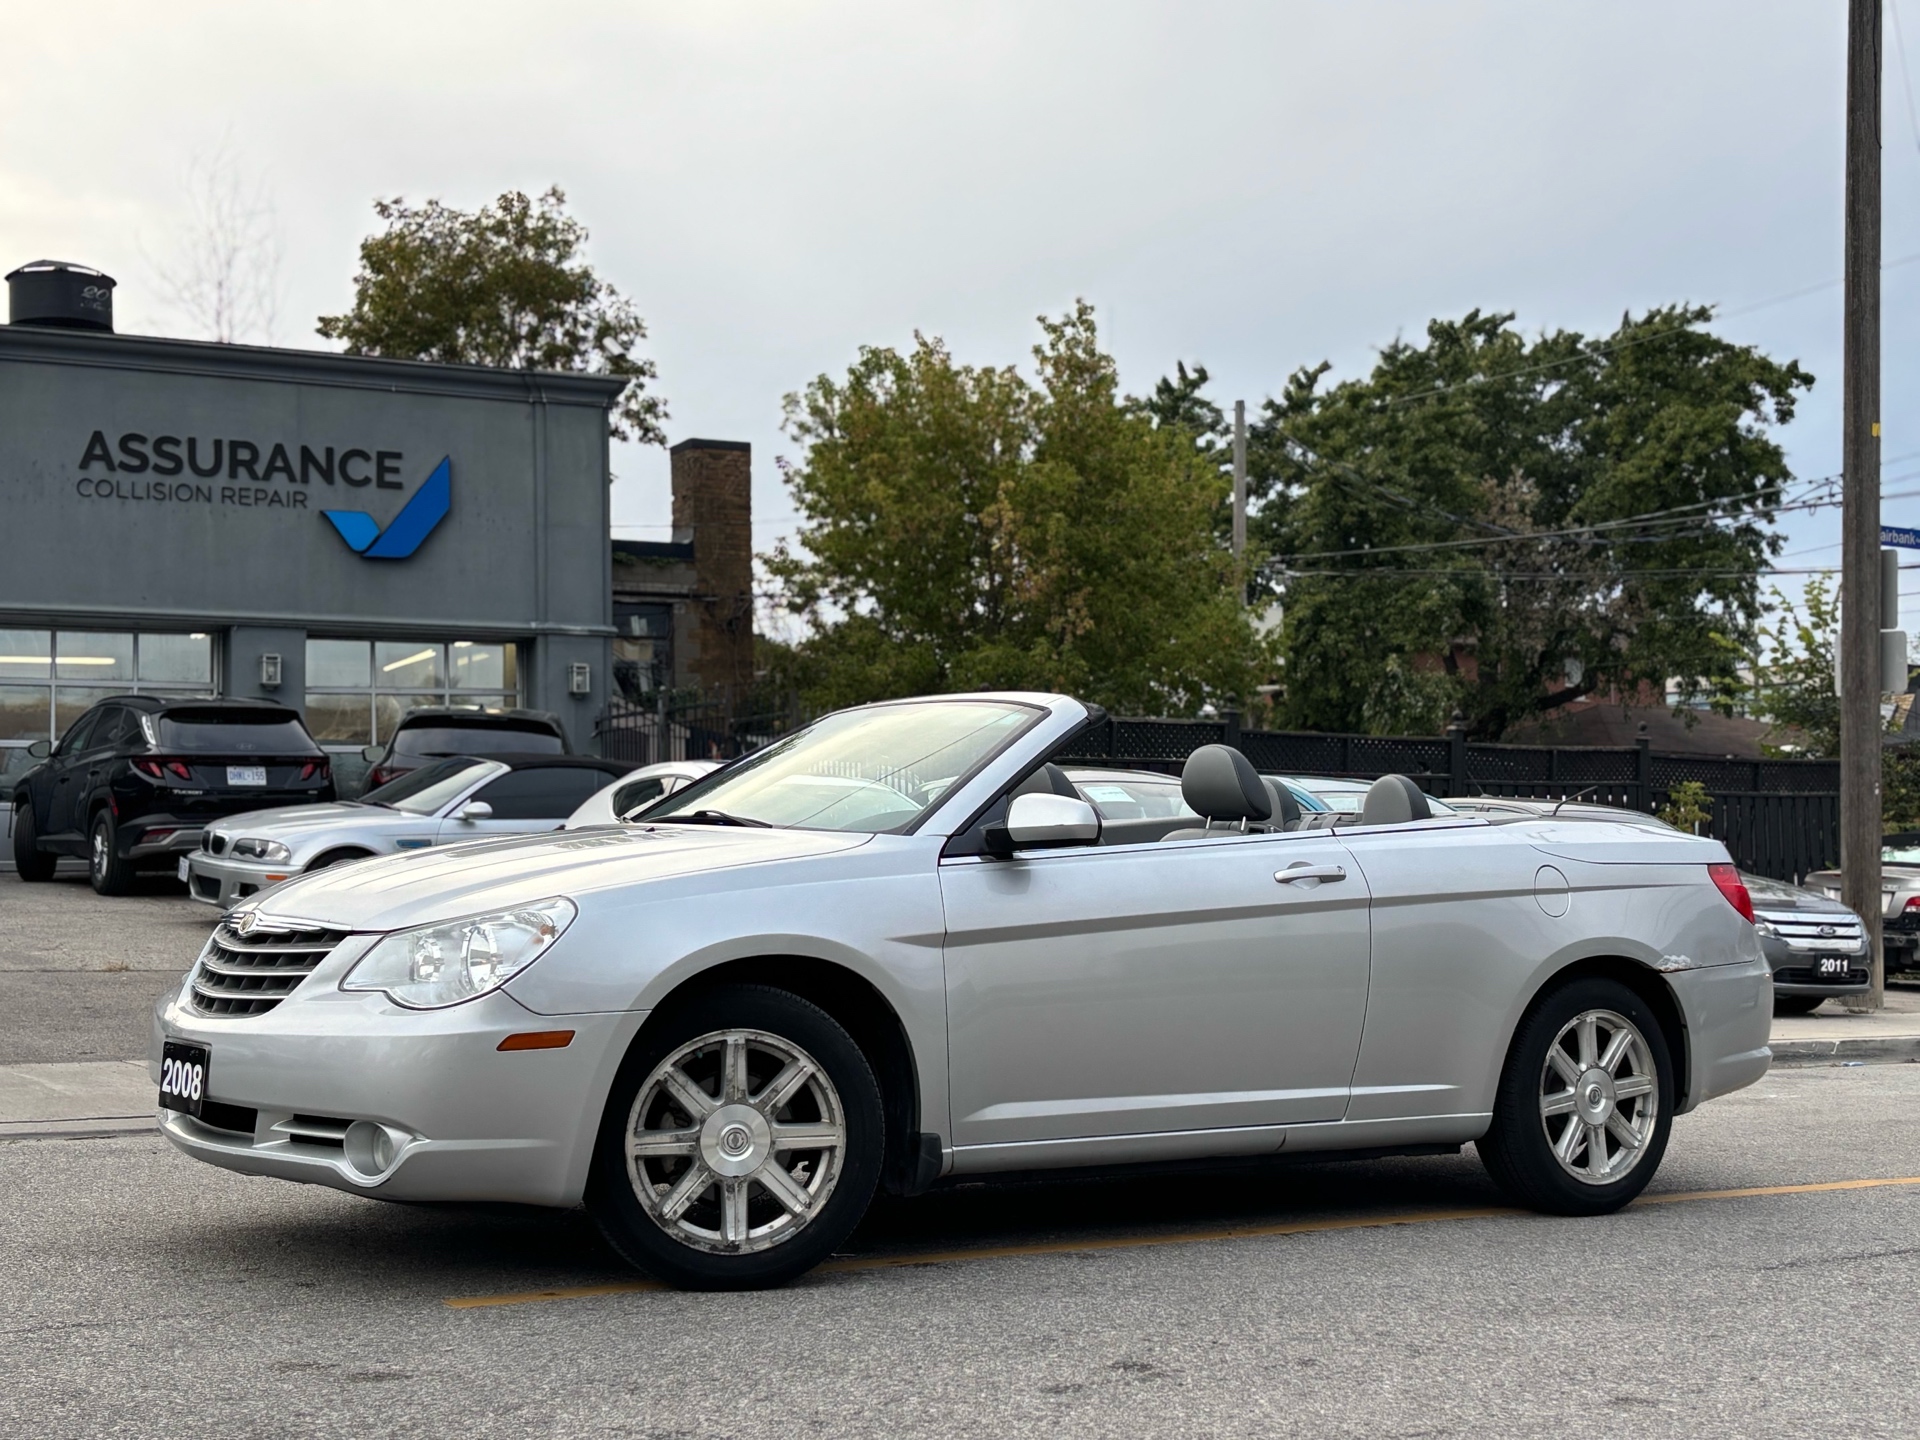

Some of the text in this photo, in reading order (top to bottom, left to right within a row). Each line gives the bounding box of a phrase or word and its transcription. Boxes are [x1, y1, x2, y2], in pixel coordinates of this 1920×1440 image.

[78, 430, 404, 490] ASSURANCE
[76, 477, 308, 509] COLLISION REPAIR
[1880, 529, 1916, 545] airbank
[1820, 958, 1849, 973] 2011
[161, 1057, 203, 1101] 2008
